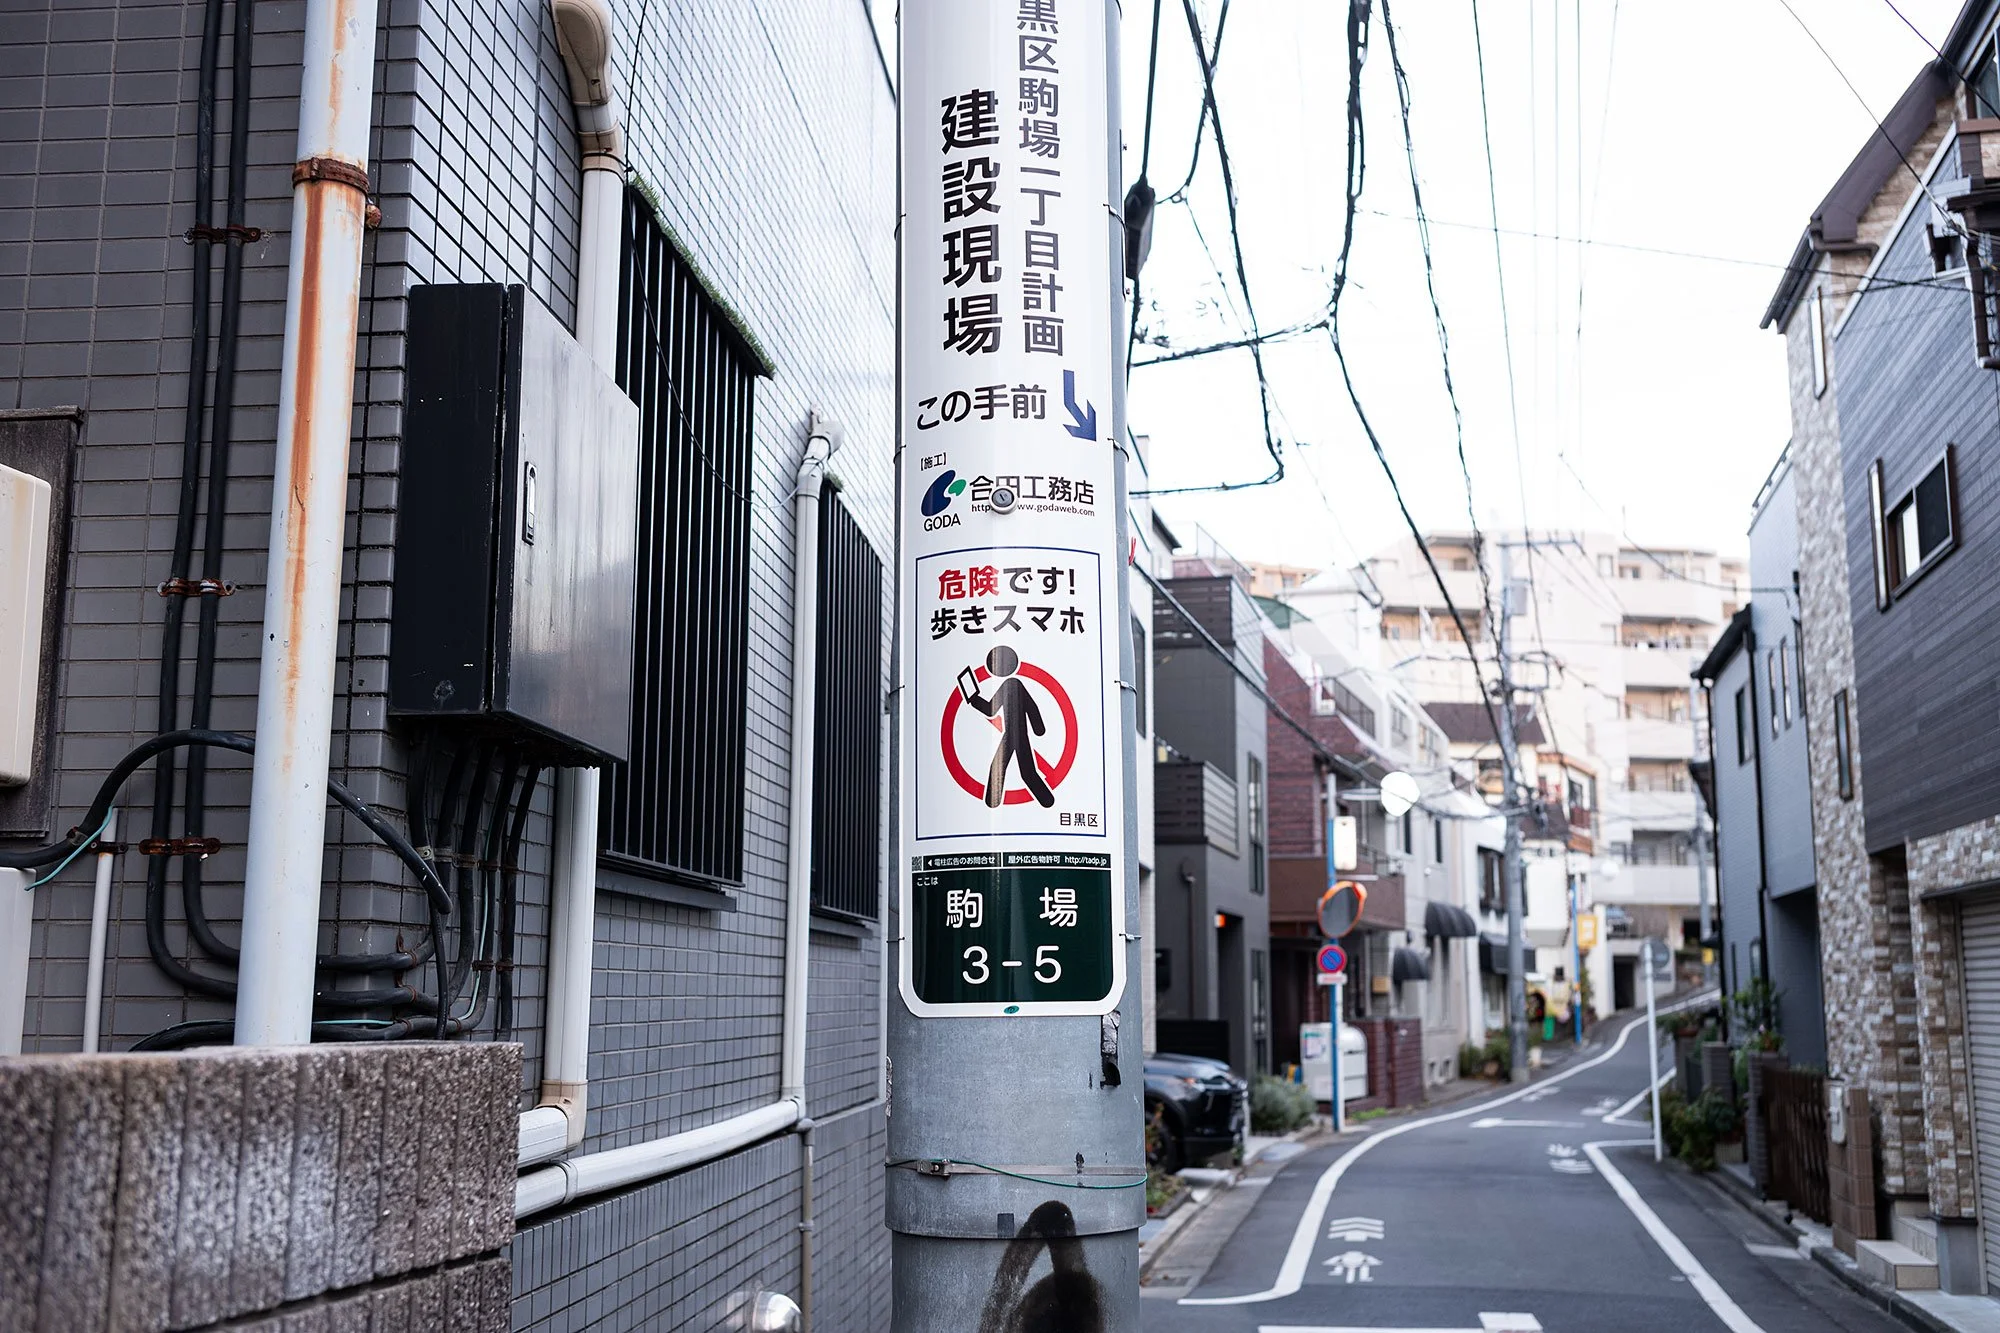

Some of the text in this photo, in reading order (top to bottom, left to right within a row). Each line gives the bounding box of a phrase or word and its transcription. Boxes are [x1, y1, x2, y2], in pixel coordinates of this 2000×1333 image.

[1017, 0, 1064, 357] 黒区駒場一丁目計画
[941, 88, 1002, 356] 建設現場
[917, 384, 1047, 430] この手前
[923, 513, 961, 532] GODA
[930, 605, 1085, 640] 歩きスマホ
[1060, 813, 1098, 827] 目黒区
[934, 855, 996, 867] 電柱広告のお問合せ
[1008, 855, 1061, 864] 屋外広告物許可
[916, 876, 938, 886] ここは
